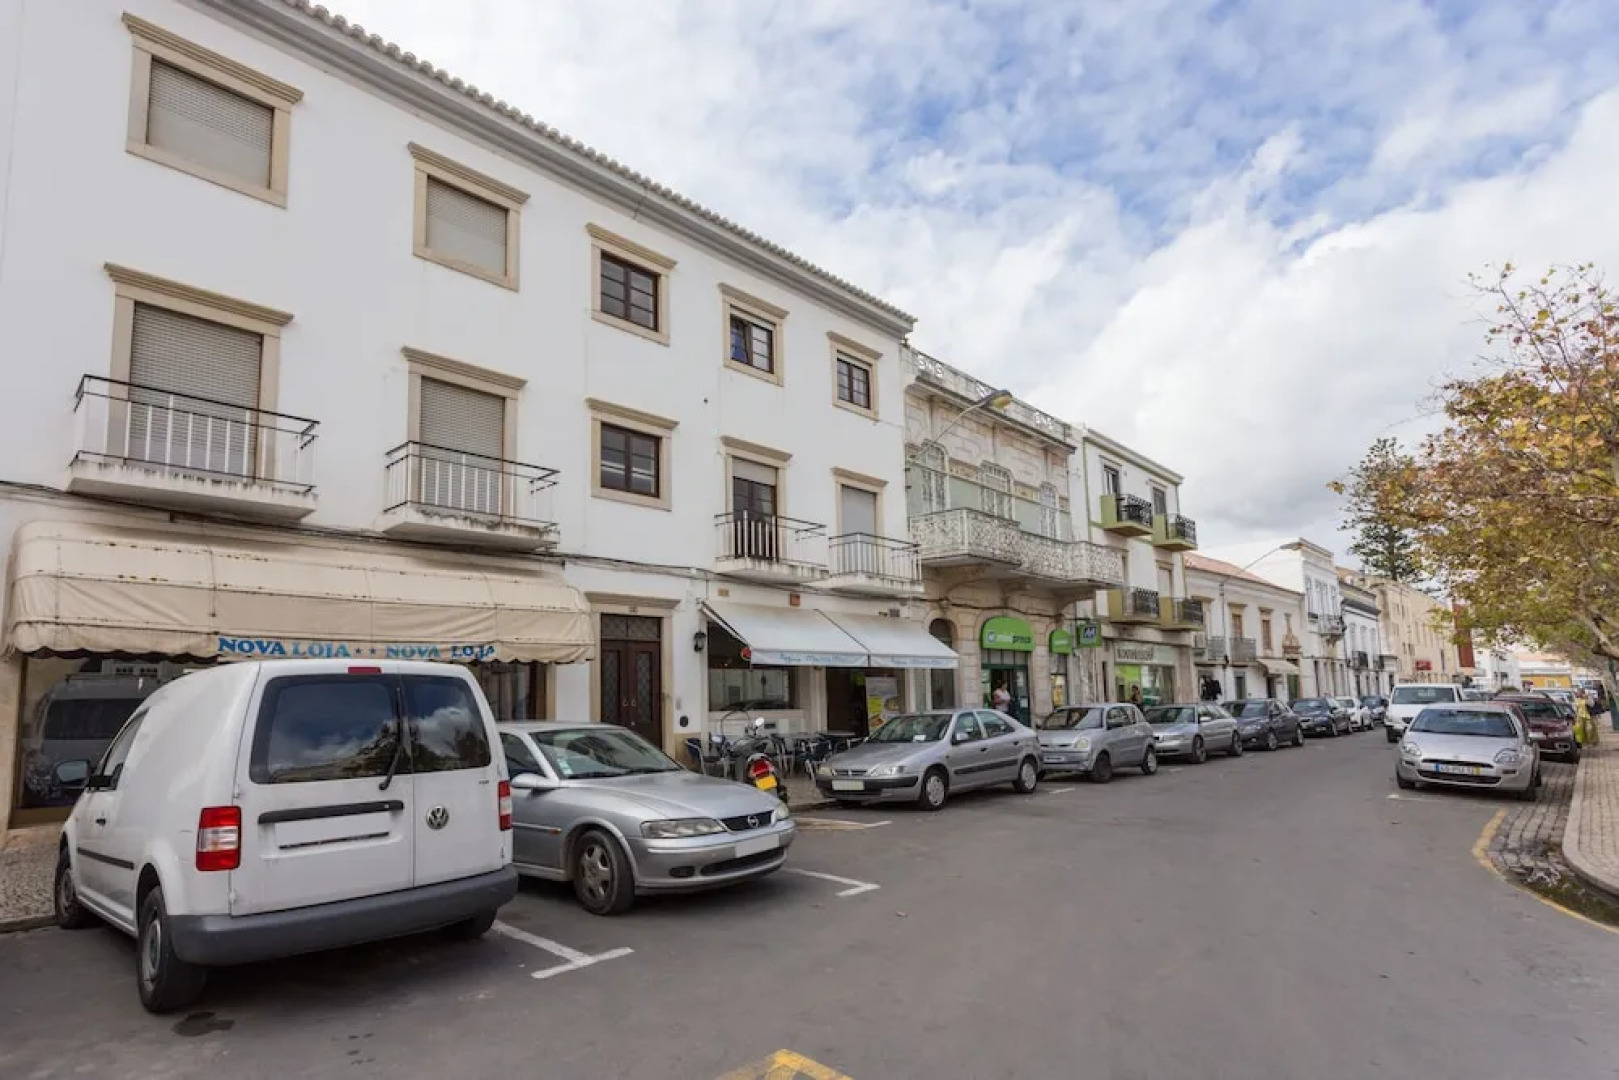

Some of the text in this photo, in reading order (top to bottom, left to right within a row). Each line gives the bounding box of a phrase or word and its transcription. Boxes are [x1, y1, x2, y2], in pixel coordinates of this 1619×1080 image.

[218, 637, 495, 660] NOVA LOJA NOVA LOJA
